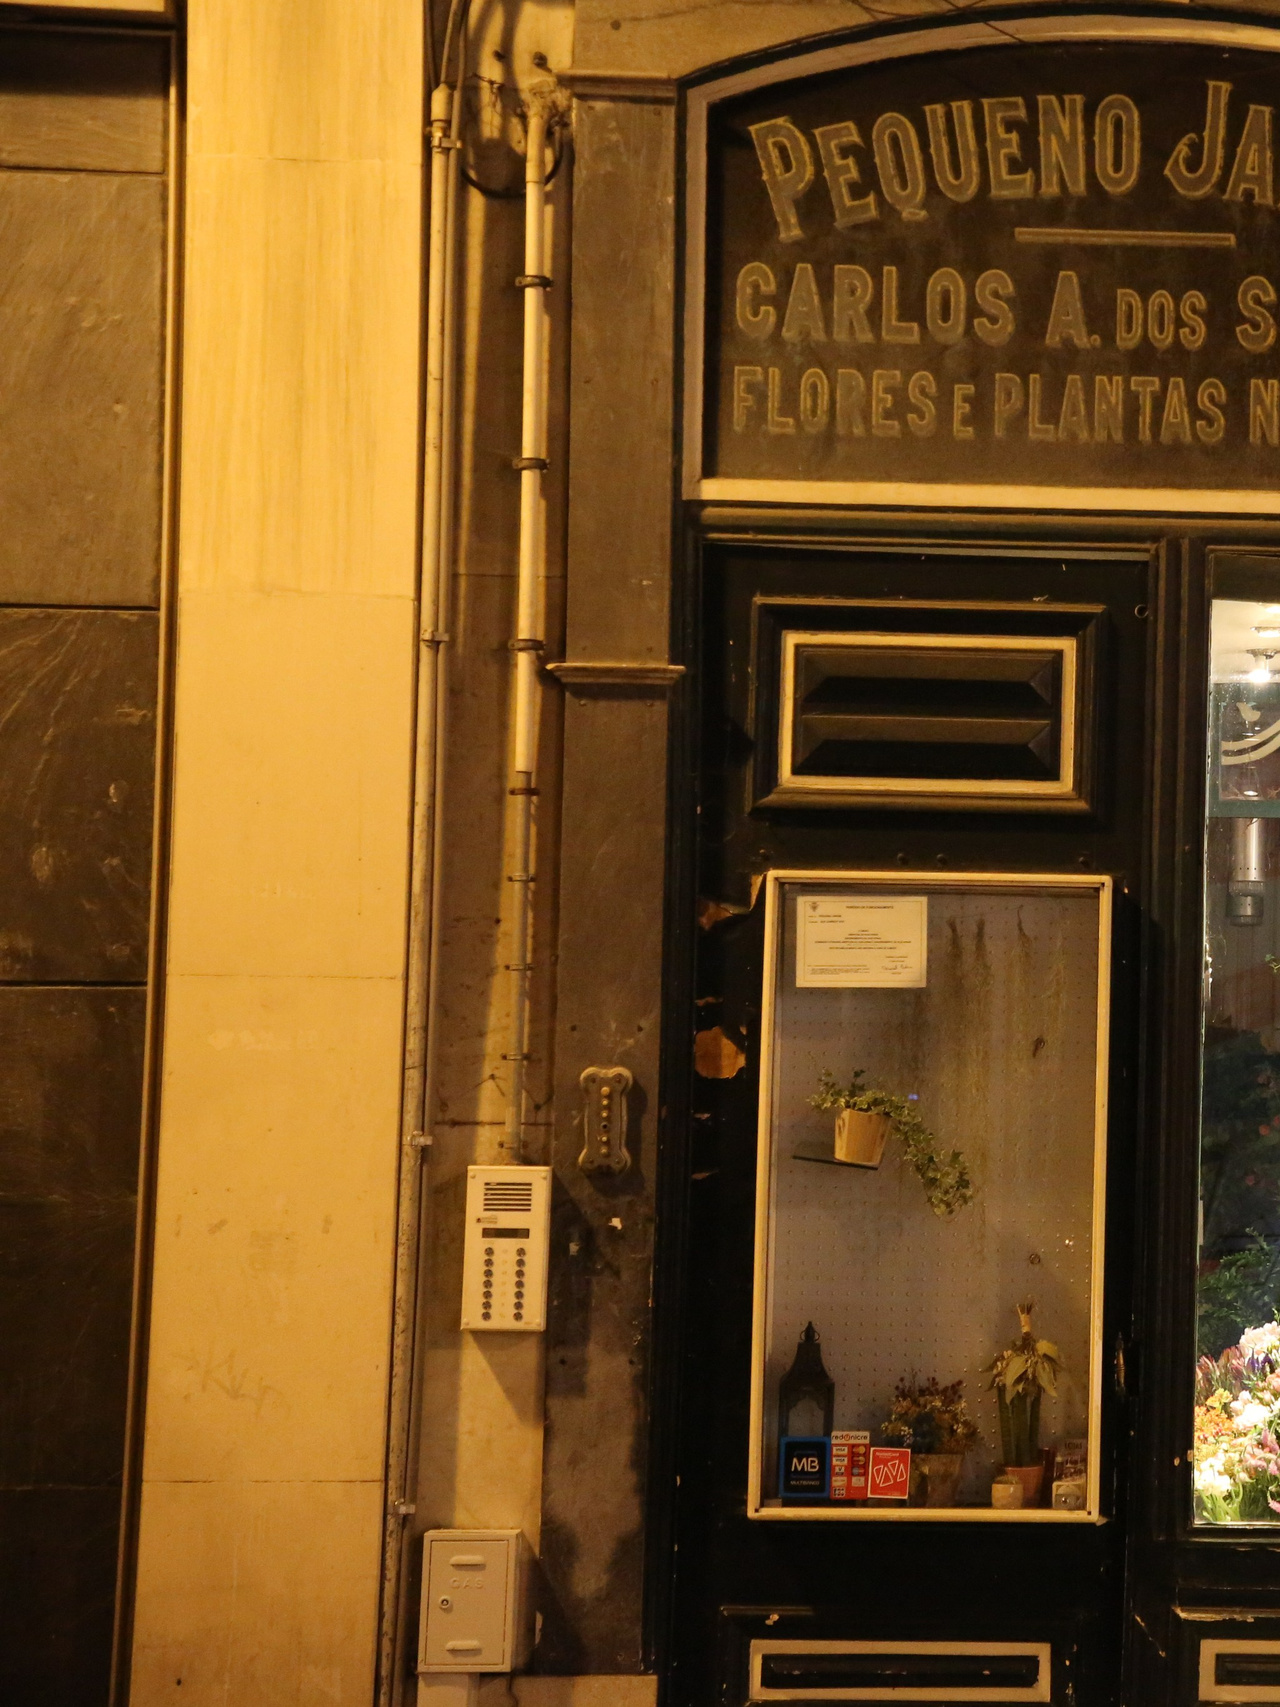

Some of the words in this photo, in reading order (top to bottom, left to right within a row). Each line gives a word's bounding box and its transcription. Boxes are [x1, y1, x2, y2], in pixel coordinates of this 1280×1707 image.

[748, 94, 1141, 244] PEQUENO
[735, 263, 1014, 345] CARLOS
[1046, 271, 1102, 349] A.
[1116, 287, 1206, 350] DOS
[733, 365, 935, 437] FLORES
[953, 383, 974, 440] E
[994, 373, 1227, 446] PLANTAS
[791, 1457, 819, 1472] MB
